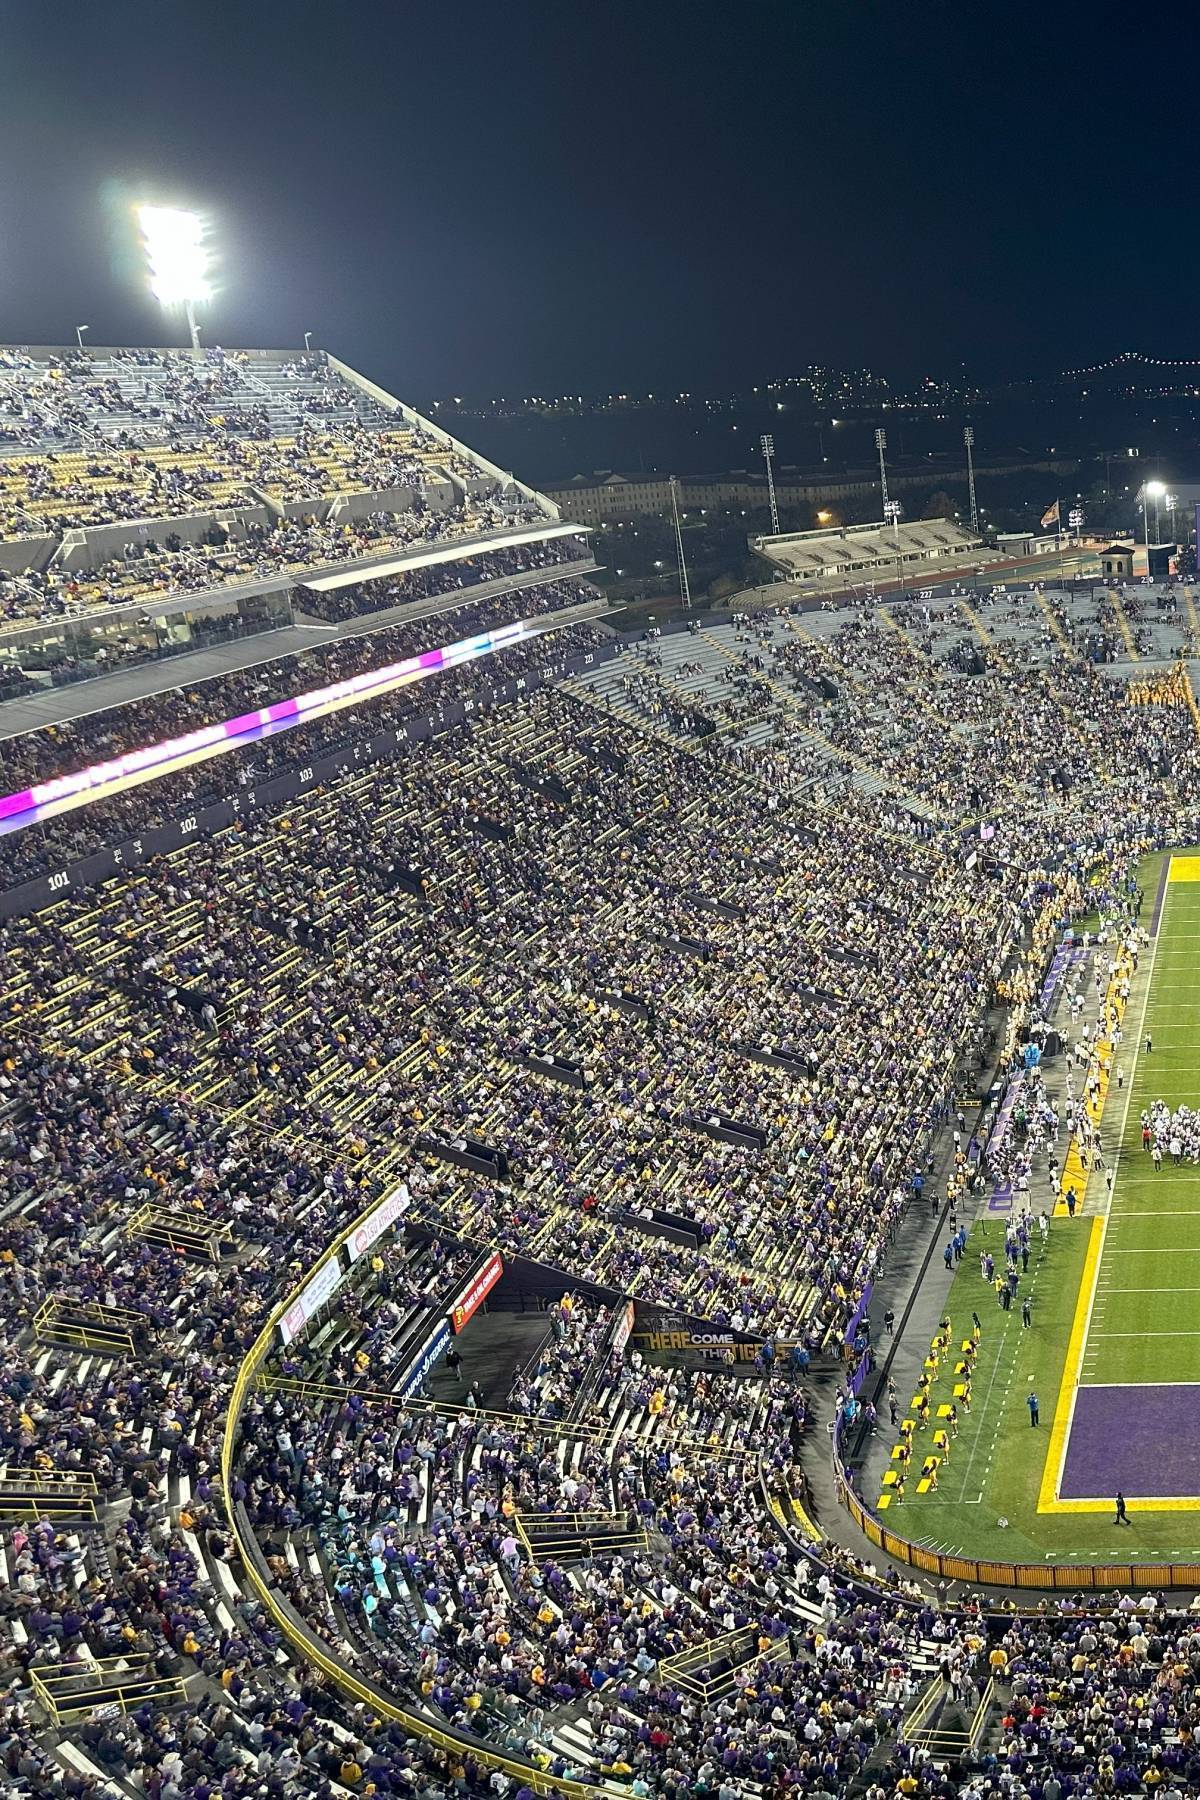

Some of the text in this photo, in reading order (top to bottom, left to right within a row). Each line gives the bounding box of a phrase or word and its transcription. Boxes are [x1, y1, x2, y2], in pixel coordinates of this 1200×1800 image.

[395, 728, 408, 741] 104
[300, 768, 313, 782] 103
[180, 817, 198, 834] 102
[48, 872, 70, 890] 101
[650, 1332, 734, 1349] HERE COME
[402, 1331, 450, 1405] CAMPUS FEDERAL
